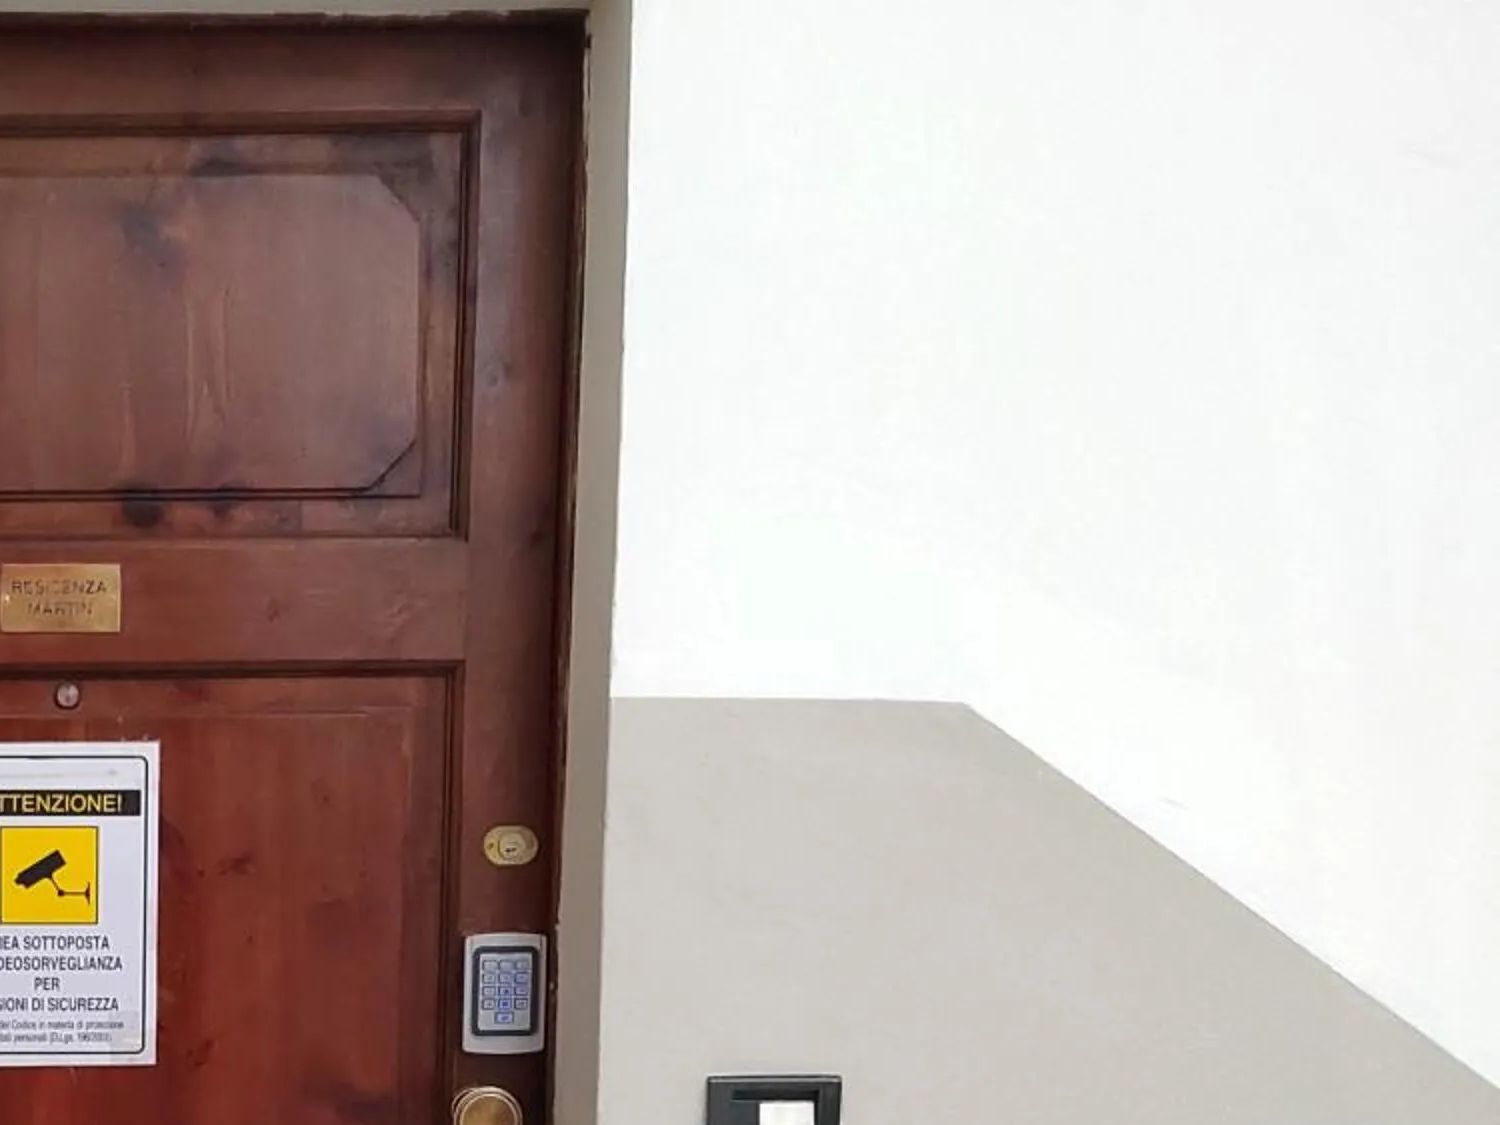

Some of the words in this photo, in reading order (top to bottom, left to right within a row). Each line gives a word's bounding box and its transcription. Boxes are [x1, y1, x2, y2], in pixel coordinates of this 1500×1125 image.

[23, 935, 110, 950] SOTTOPOSTA
[34, 977, 60, 991] PER
[31, 997, 46, 1012] DI
[48, 997, 119, 1012] SICUREZZA
